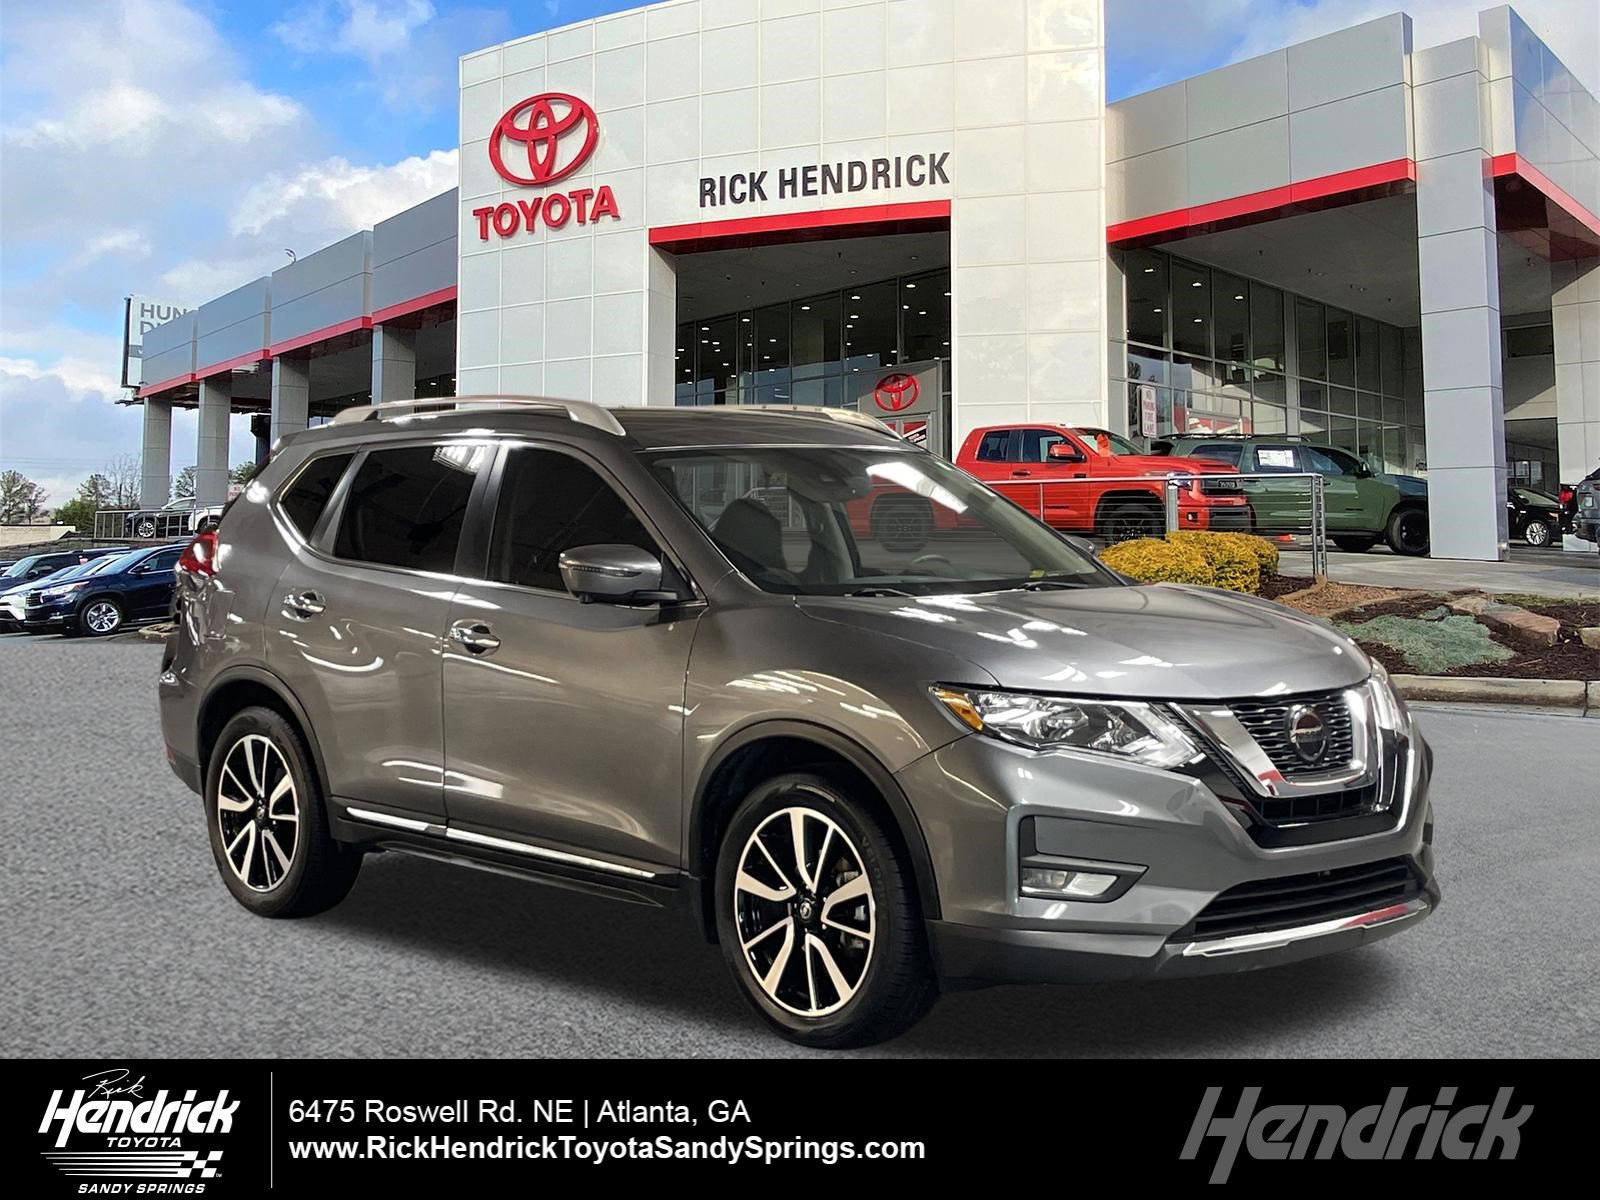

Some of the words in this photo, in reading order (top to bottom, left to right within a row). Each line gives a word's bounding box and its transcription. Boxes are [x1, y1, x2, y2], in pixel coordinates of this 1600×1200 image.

[699, 170, 768, 208] RICK
[779, 152, 951, 199] HENDRICK
[473, 185, 620, 240] TOYOTA
